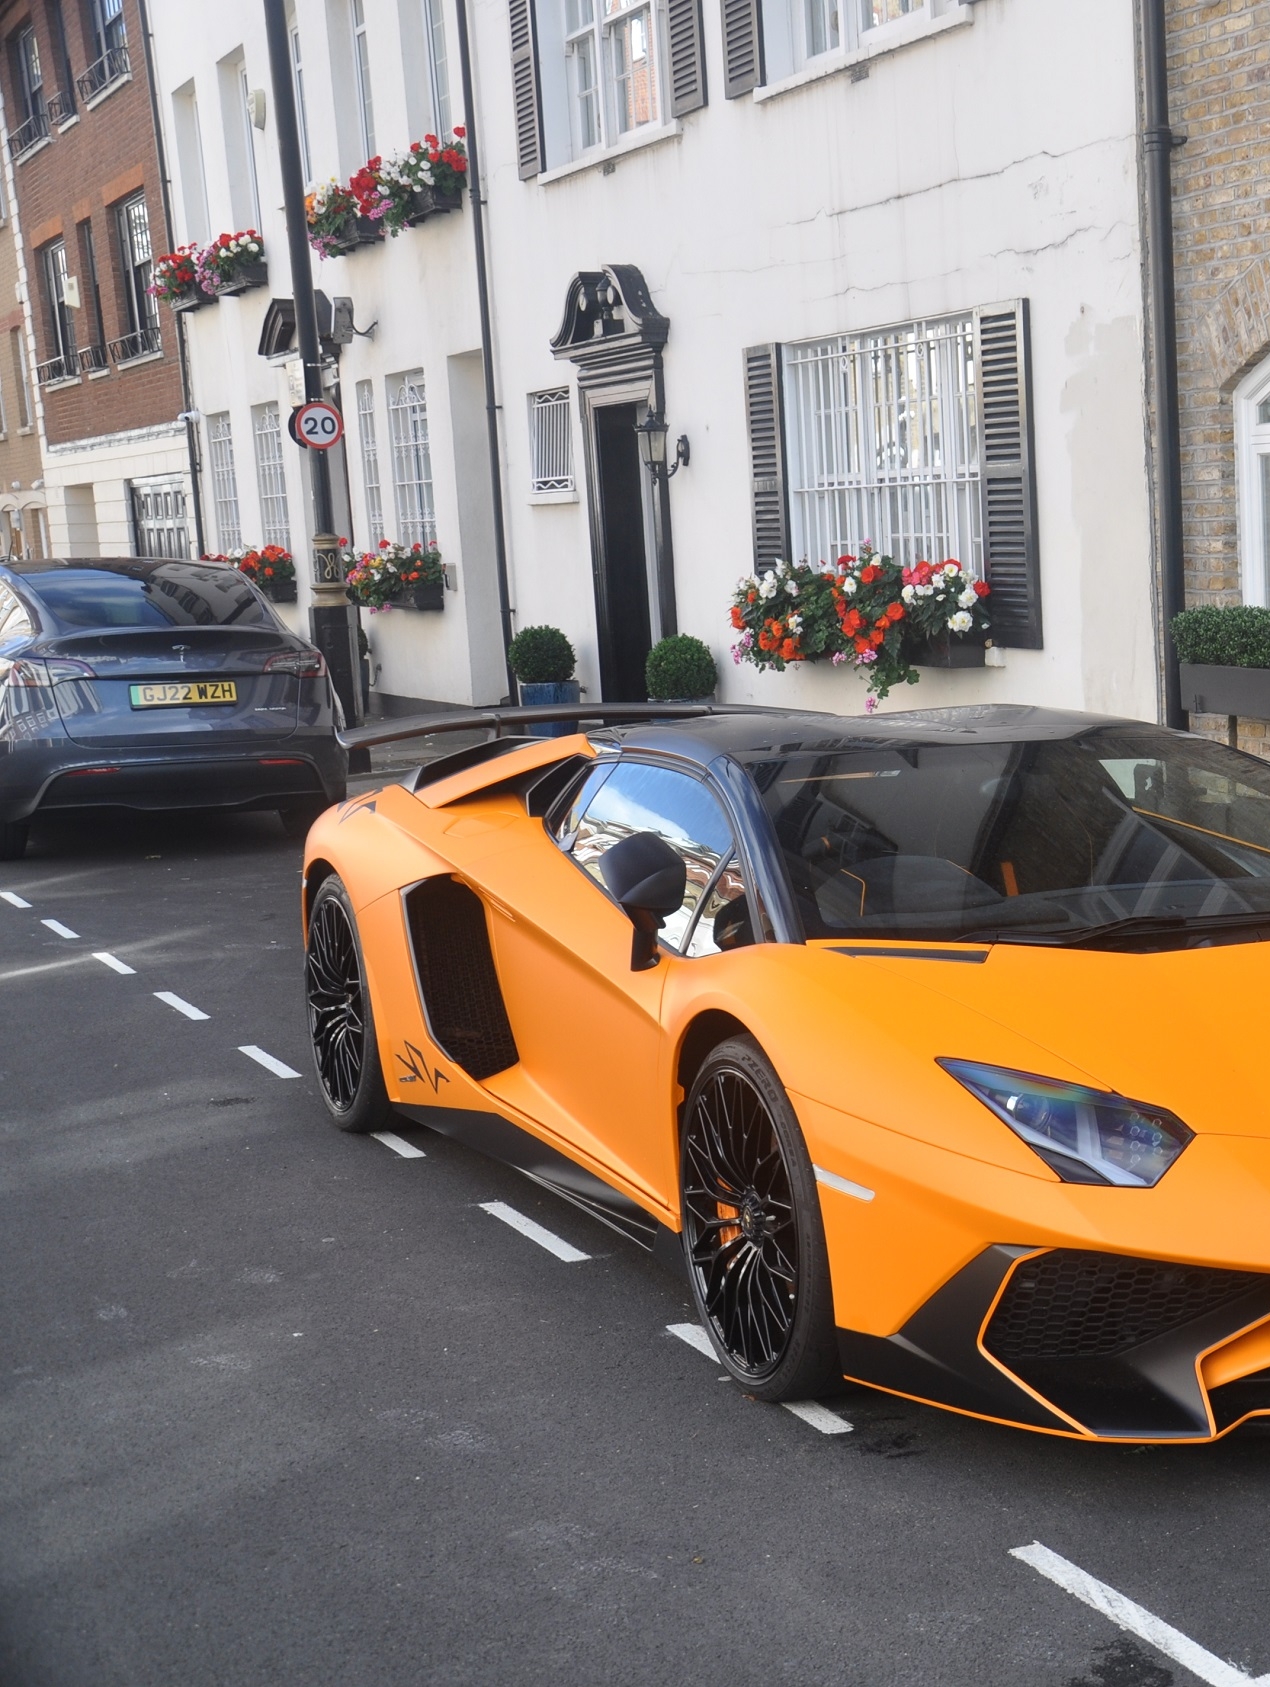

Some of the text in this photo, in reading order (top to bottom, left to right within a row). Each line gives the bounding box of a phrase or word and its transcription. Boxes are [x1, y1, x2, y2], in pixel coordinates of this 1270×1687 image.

[304, 416, 336, 435] 20
[142, 683, 233, 702] GJ22 WZH
